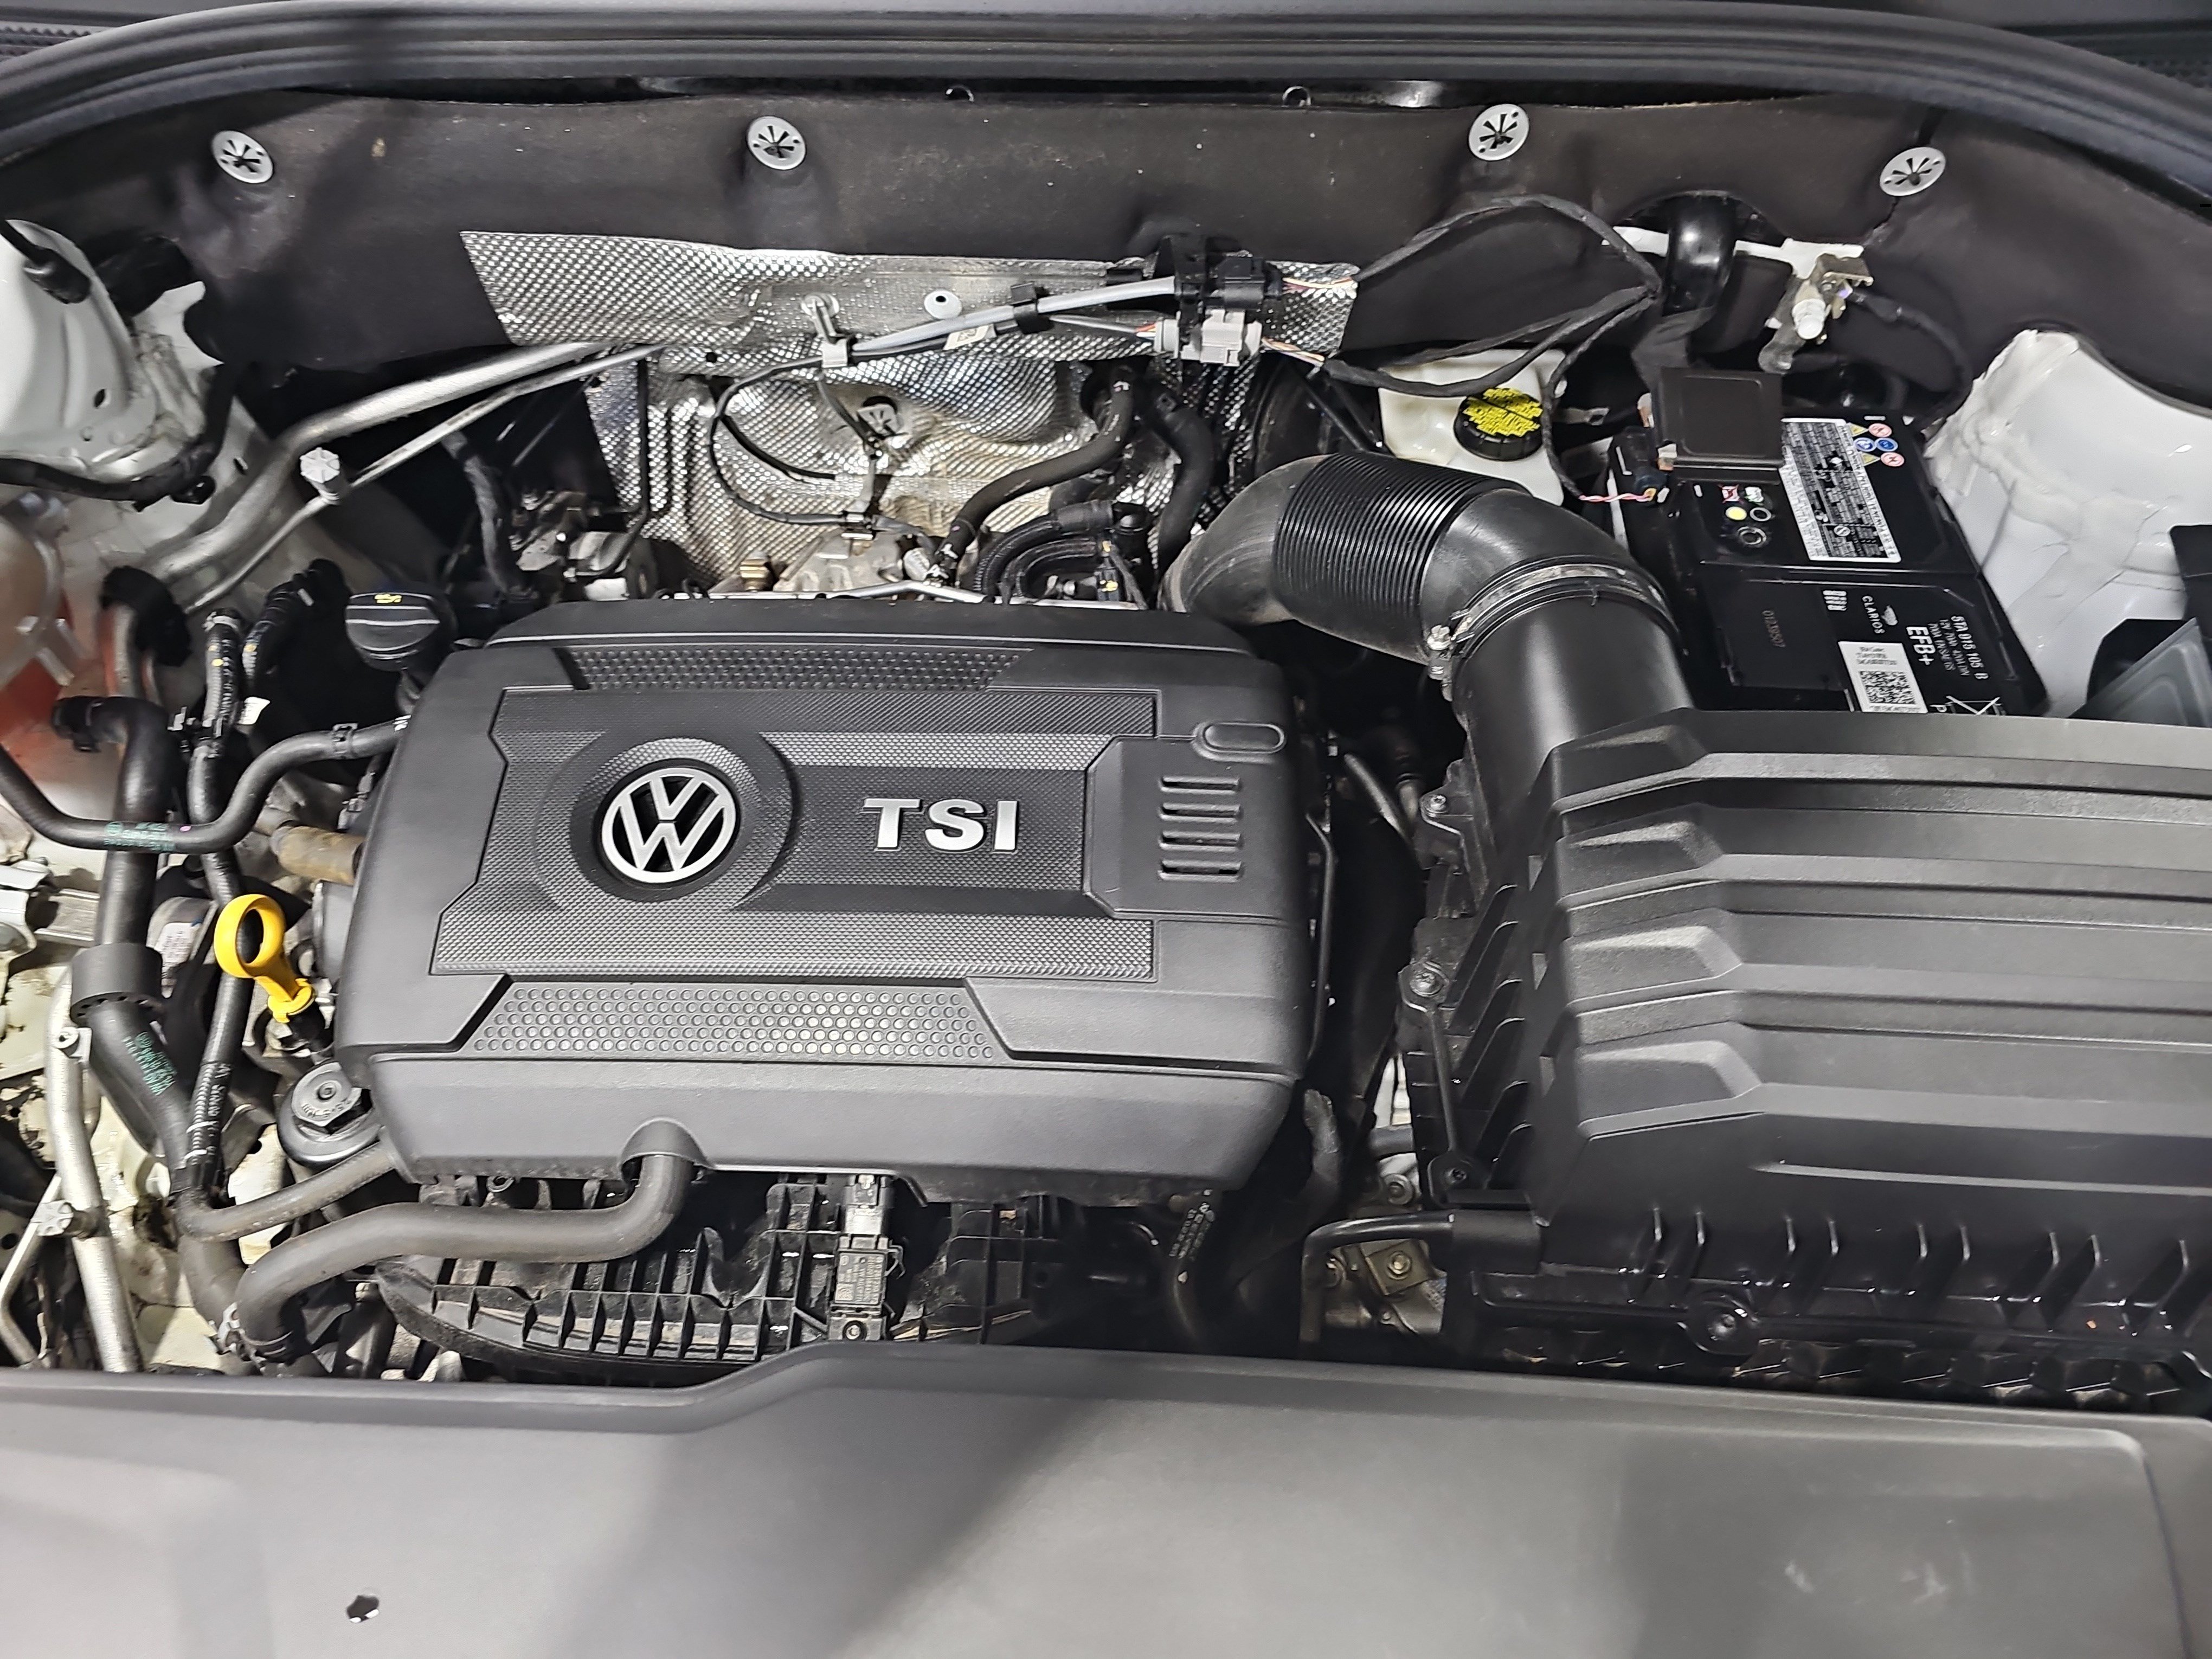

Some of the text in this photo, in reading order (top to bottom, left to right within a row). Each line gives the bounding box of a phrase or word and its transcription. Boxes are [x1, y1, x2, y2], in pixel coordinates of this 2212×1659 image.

[1862, 595, 1886, 634] CLARIOS
[1906, 626, 1936, 665] EFB+
[1966, 653, 1985, 668] 105
[863, 798, 1018, 851] TSI
